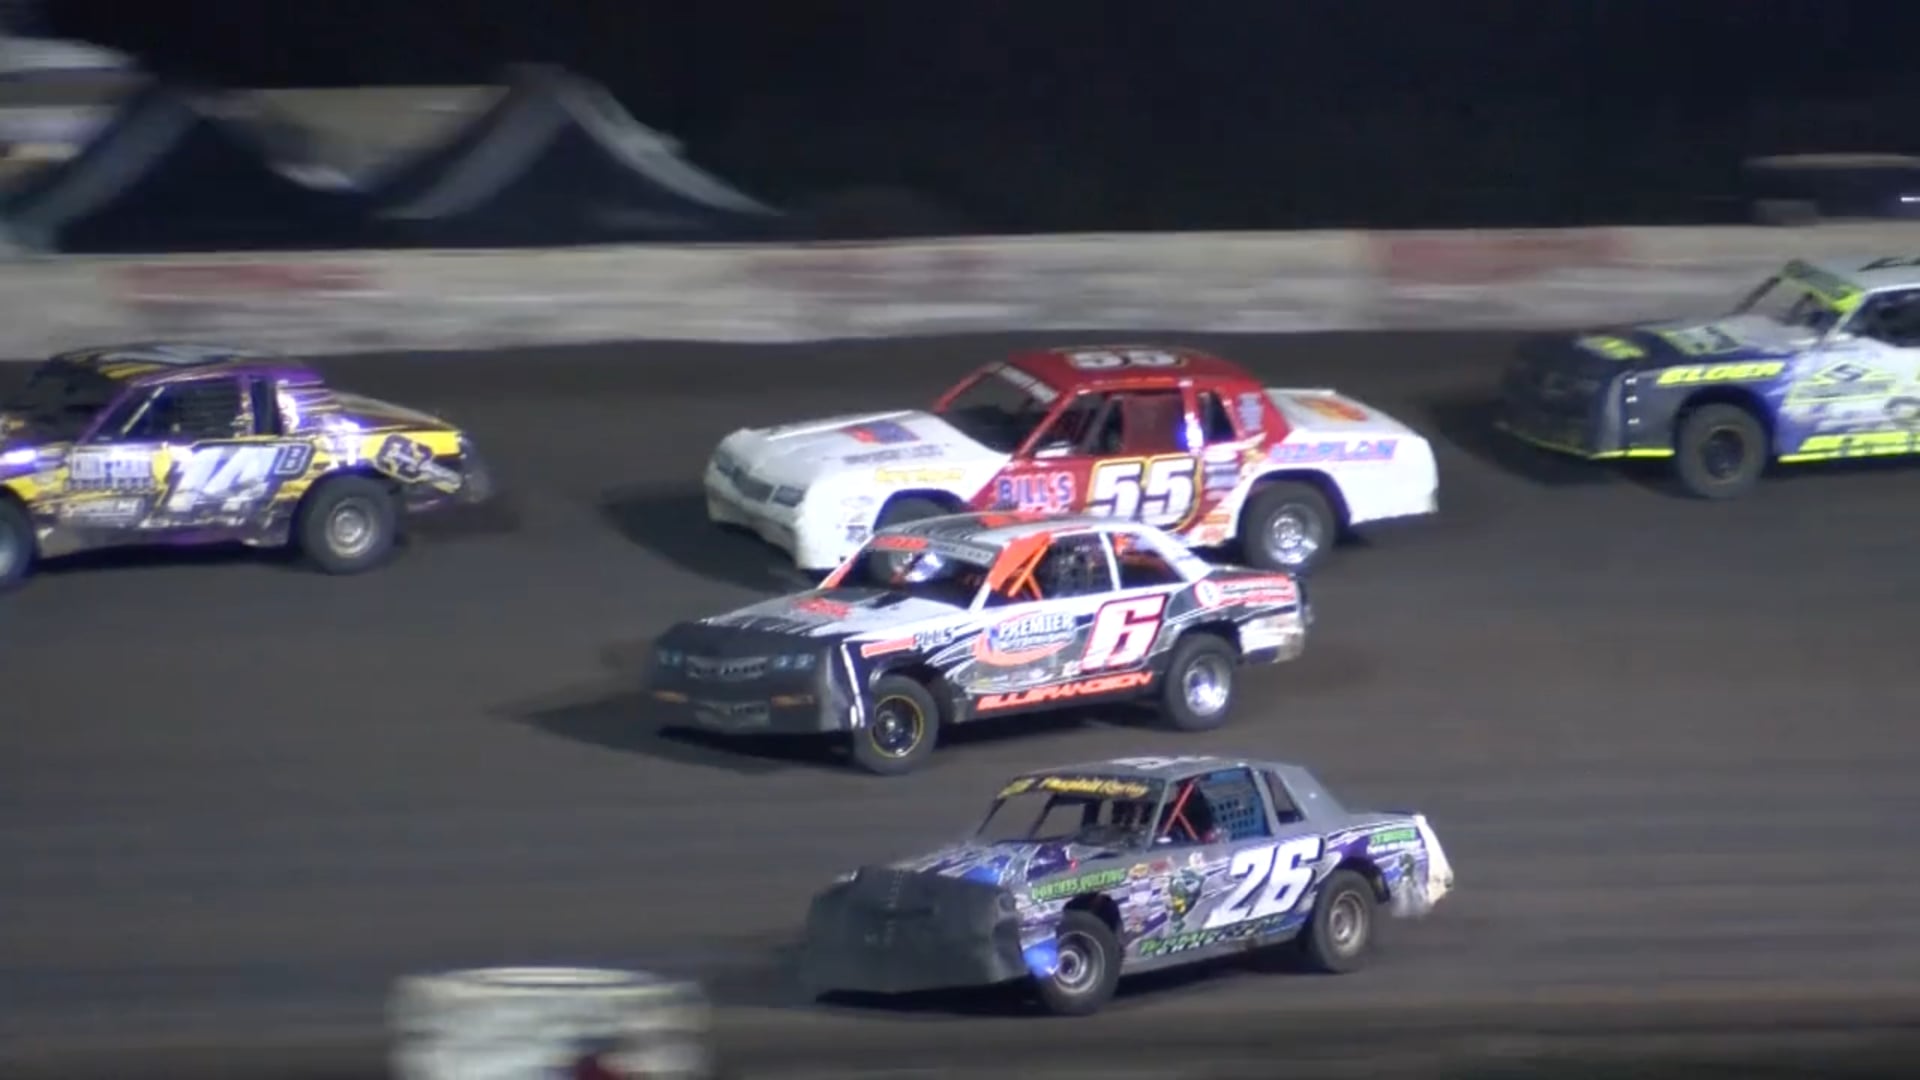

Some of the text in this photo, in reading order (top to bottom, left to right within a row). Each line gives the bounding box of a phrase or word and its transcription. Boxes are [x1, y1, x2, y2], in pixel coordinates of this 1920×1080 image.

[1088, 455, 1200, 532] 55
[999, 611, 1076, 642] PREMIER
[1081, 594, 1168, 673] 6
[1203, 836, 1324, 929] 26
